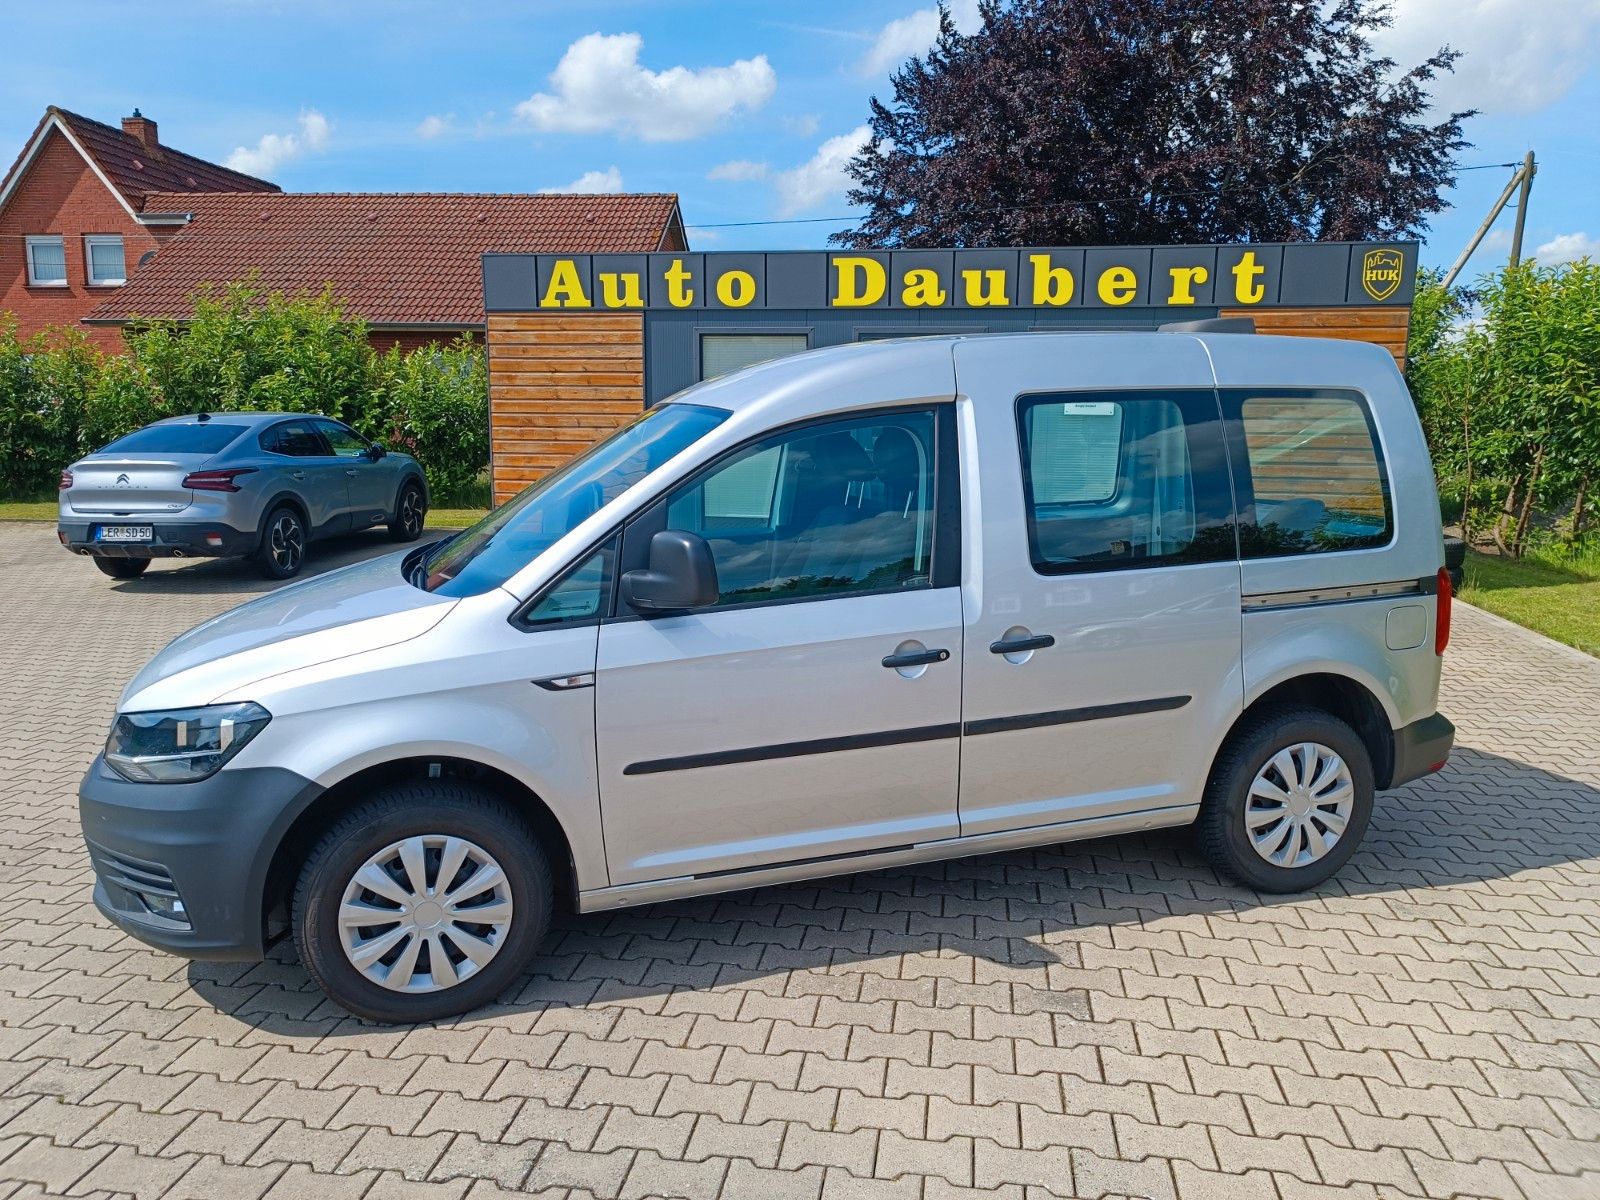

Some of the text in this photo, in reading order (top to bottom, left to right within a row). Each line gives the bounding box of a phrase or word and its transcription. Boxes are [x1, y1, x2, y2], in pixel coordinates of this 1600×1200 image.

[540, 251, 1265, 309] Auto Daubert
[1365, 269, 1399, 281] HUK
